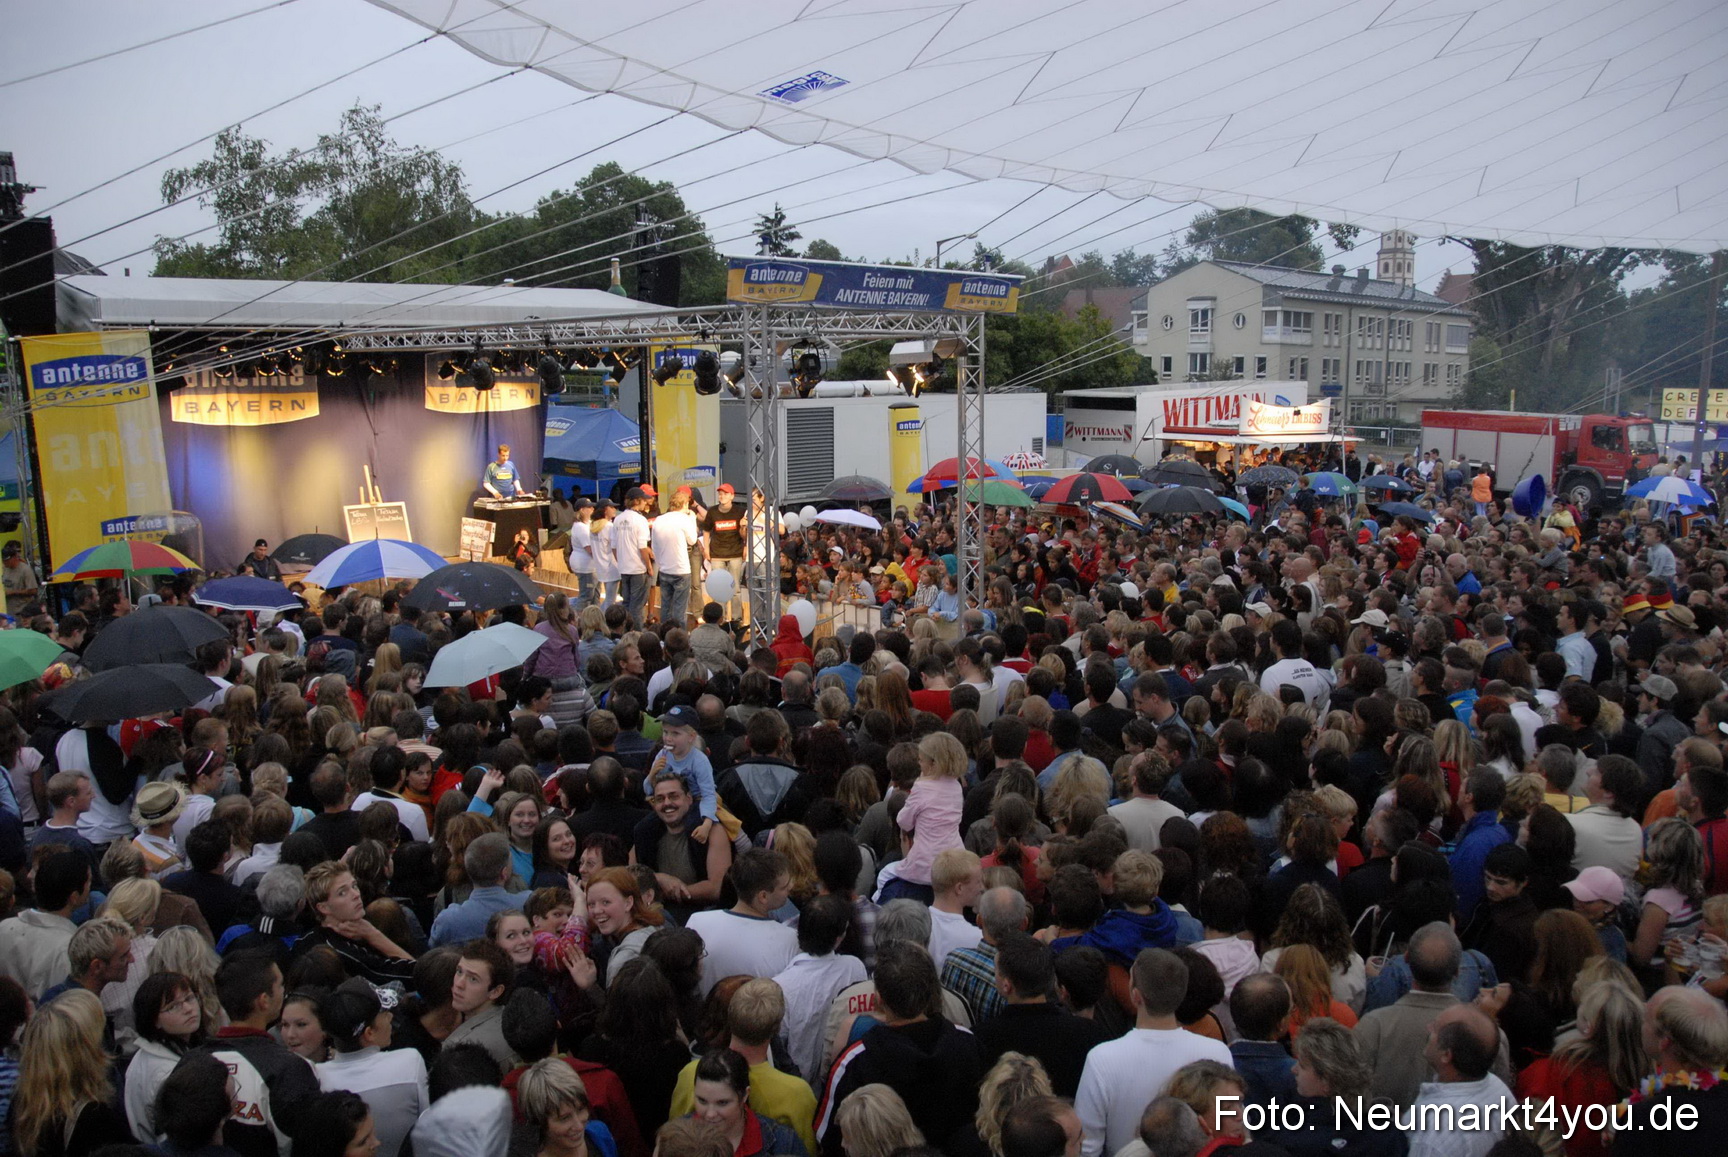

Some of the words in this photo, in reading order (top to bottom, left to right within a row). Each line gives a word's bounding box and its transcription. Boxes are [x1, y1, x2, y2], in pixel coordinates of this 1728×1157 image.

[750, 266, 803, 283] antenne
[863, 272, 895, 288] Feiern
[896, 275, 914, 290] mit
[963, 281, 1006, 296] antenne
[835, 288, 887, 305] ANTENNE
[887, 291, 930, 306] BAYERN!
[960, 297, 1003, 306] BAYERN
[42, 362, 139, 384] antenne
[439, 388, 535, 404] BAYERN
[184, 399, 306, 414] BAYERN
[1292, 411, 1323, 424] IMBISS
[1074, 426, 1123, 436] WITTMANN
[107, 518, 163, 534] antenne
